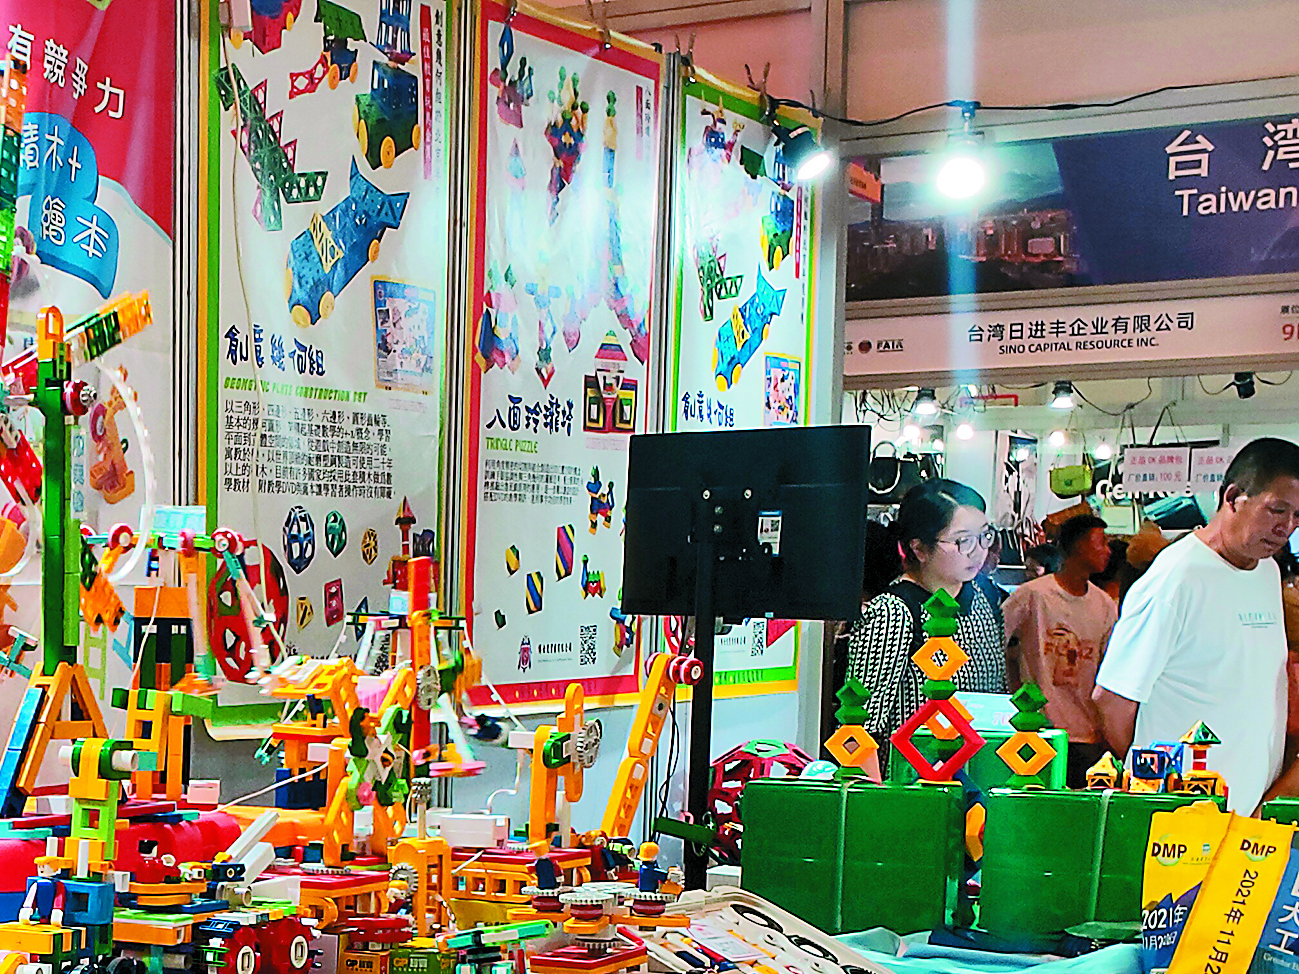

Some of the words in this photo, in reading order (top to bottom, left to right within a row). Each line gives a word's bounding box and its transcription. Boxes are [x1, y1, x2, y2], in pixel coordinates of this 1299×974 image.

[1174, 185, 1298, 217] Taiwan
[967, 311, 1196, 344] 台湾日进丰企业有限公司
[998, 344, 1025, 355] SINO
[1028, 341, 1073, 353] CAPITAL
[1075, 338, 1134, 351] RESOURCE
[1137, 337, 1160, 348] INC.
[1151, 841, 1188, 859] DMP
[1239, 838, 1277, 858] DMP
[1142, 903, 1189, 931] 2021年
